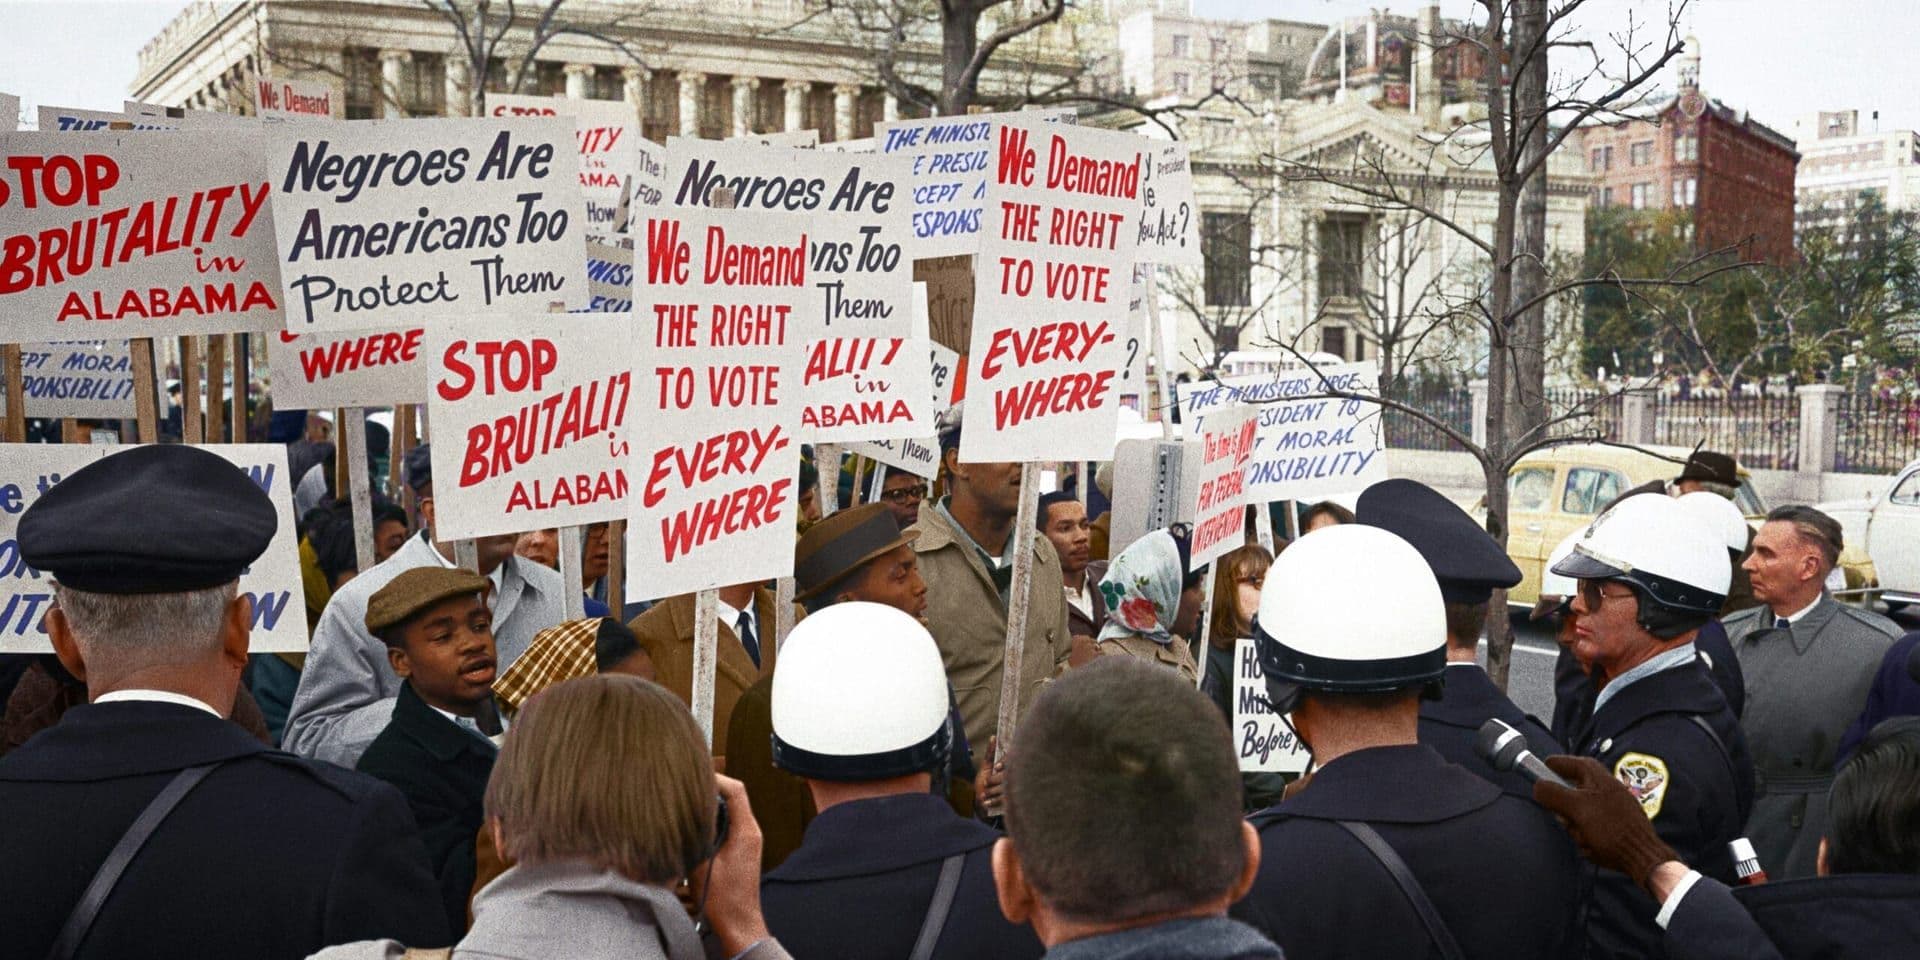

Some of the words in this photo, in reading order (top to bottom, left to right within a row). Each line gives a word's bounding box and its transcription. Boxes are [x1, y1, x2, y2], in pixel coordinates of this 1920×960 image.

[260, 82, 279, 110] We
[284, 85, 329, 115] Demand
[885, 127, 924, 152] THE
[998, 125, 1036, 188] We
[1046, 134, 1141, 200] Demand
[283, 140, 469, 203] Negroes
[476, 131, 554, 181] Are
[828, 167, 895, 213] Are
[635, 184, 662, 206] FOR
[913, 184, 963, 204] CEPT
[0, 182, 270, 294] BRUTALITY
[288, 207, 509, 262] Americans
[517, 192, 568, 244] Too
[1001, 201, 1041, 243] THE
[1050, 207, 1124, 250] RIGHT
[193, 247, 245, 273] in
[648, 219, 690, 286] We
[704, 226, 807, 287] Demand
[856, 226, 900, 273] Too
[57, 281, 277, 321] ALABAMA
[291, 275, 458, 323] Protect
[471, 255, 565, 305] Them
[817, 281, 893, 325] Them
[1000, 257, 1033, 297] TO
[1047, 262, 1110, 303] VOTE
[654, 305, 699, 347] THE
[711, 305, 791, 346] RIGHT
[62, 352, 133, 371] MORA
[300, 328, 424, 383] WHERE
[437, 339, 558, 401] STOP
[981, 320, 1115, 379] EVERY-
[656, 367, 694, 409] TO
[709, 366, 780, 408] VOTE
[855, 374, 891, 393] in
[994, 370, 1115, 431] WHERE
[1189, 391, 1219, 413] THE
[1227, 378, 1311, 402] MINISTERS
[1338, 400, 1360, 418] TO
[1277, 427, 1354, 451] MORAL
[644, 424, 790, 509] EVERY-
[661, 478, 792, 563] WHERE
[1241, 720, 1293, 765] Before
